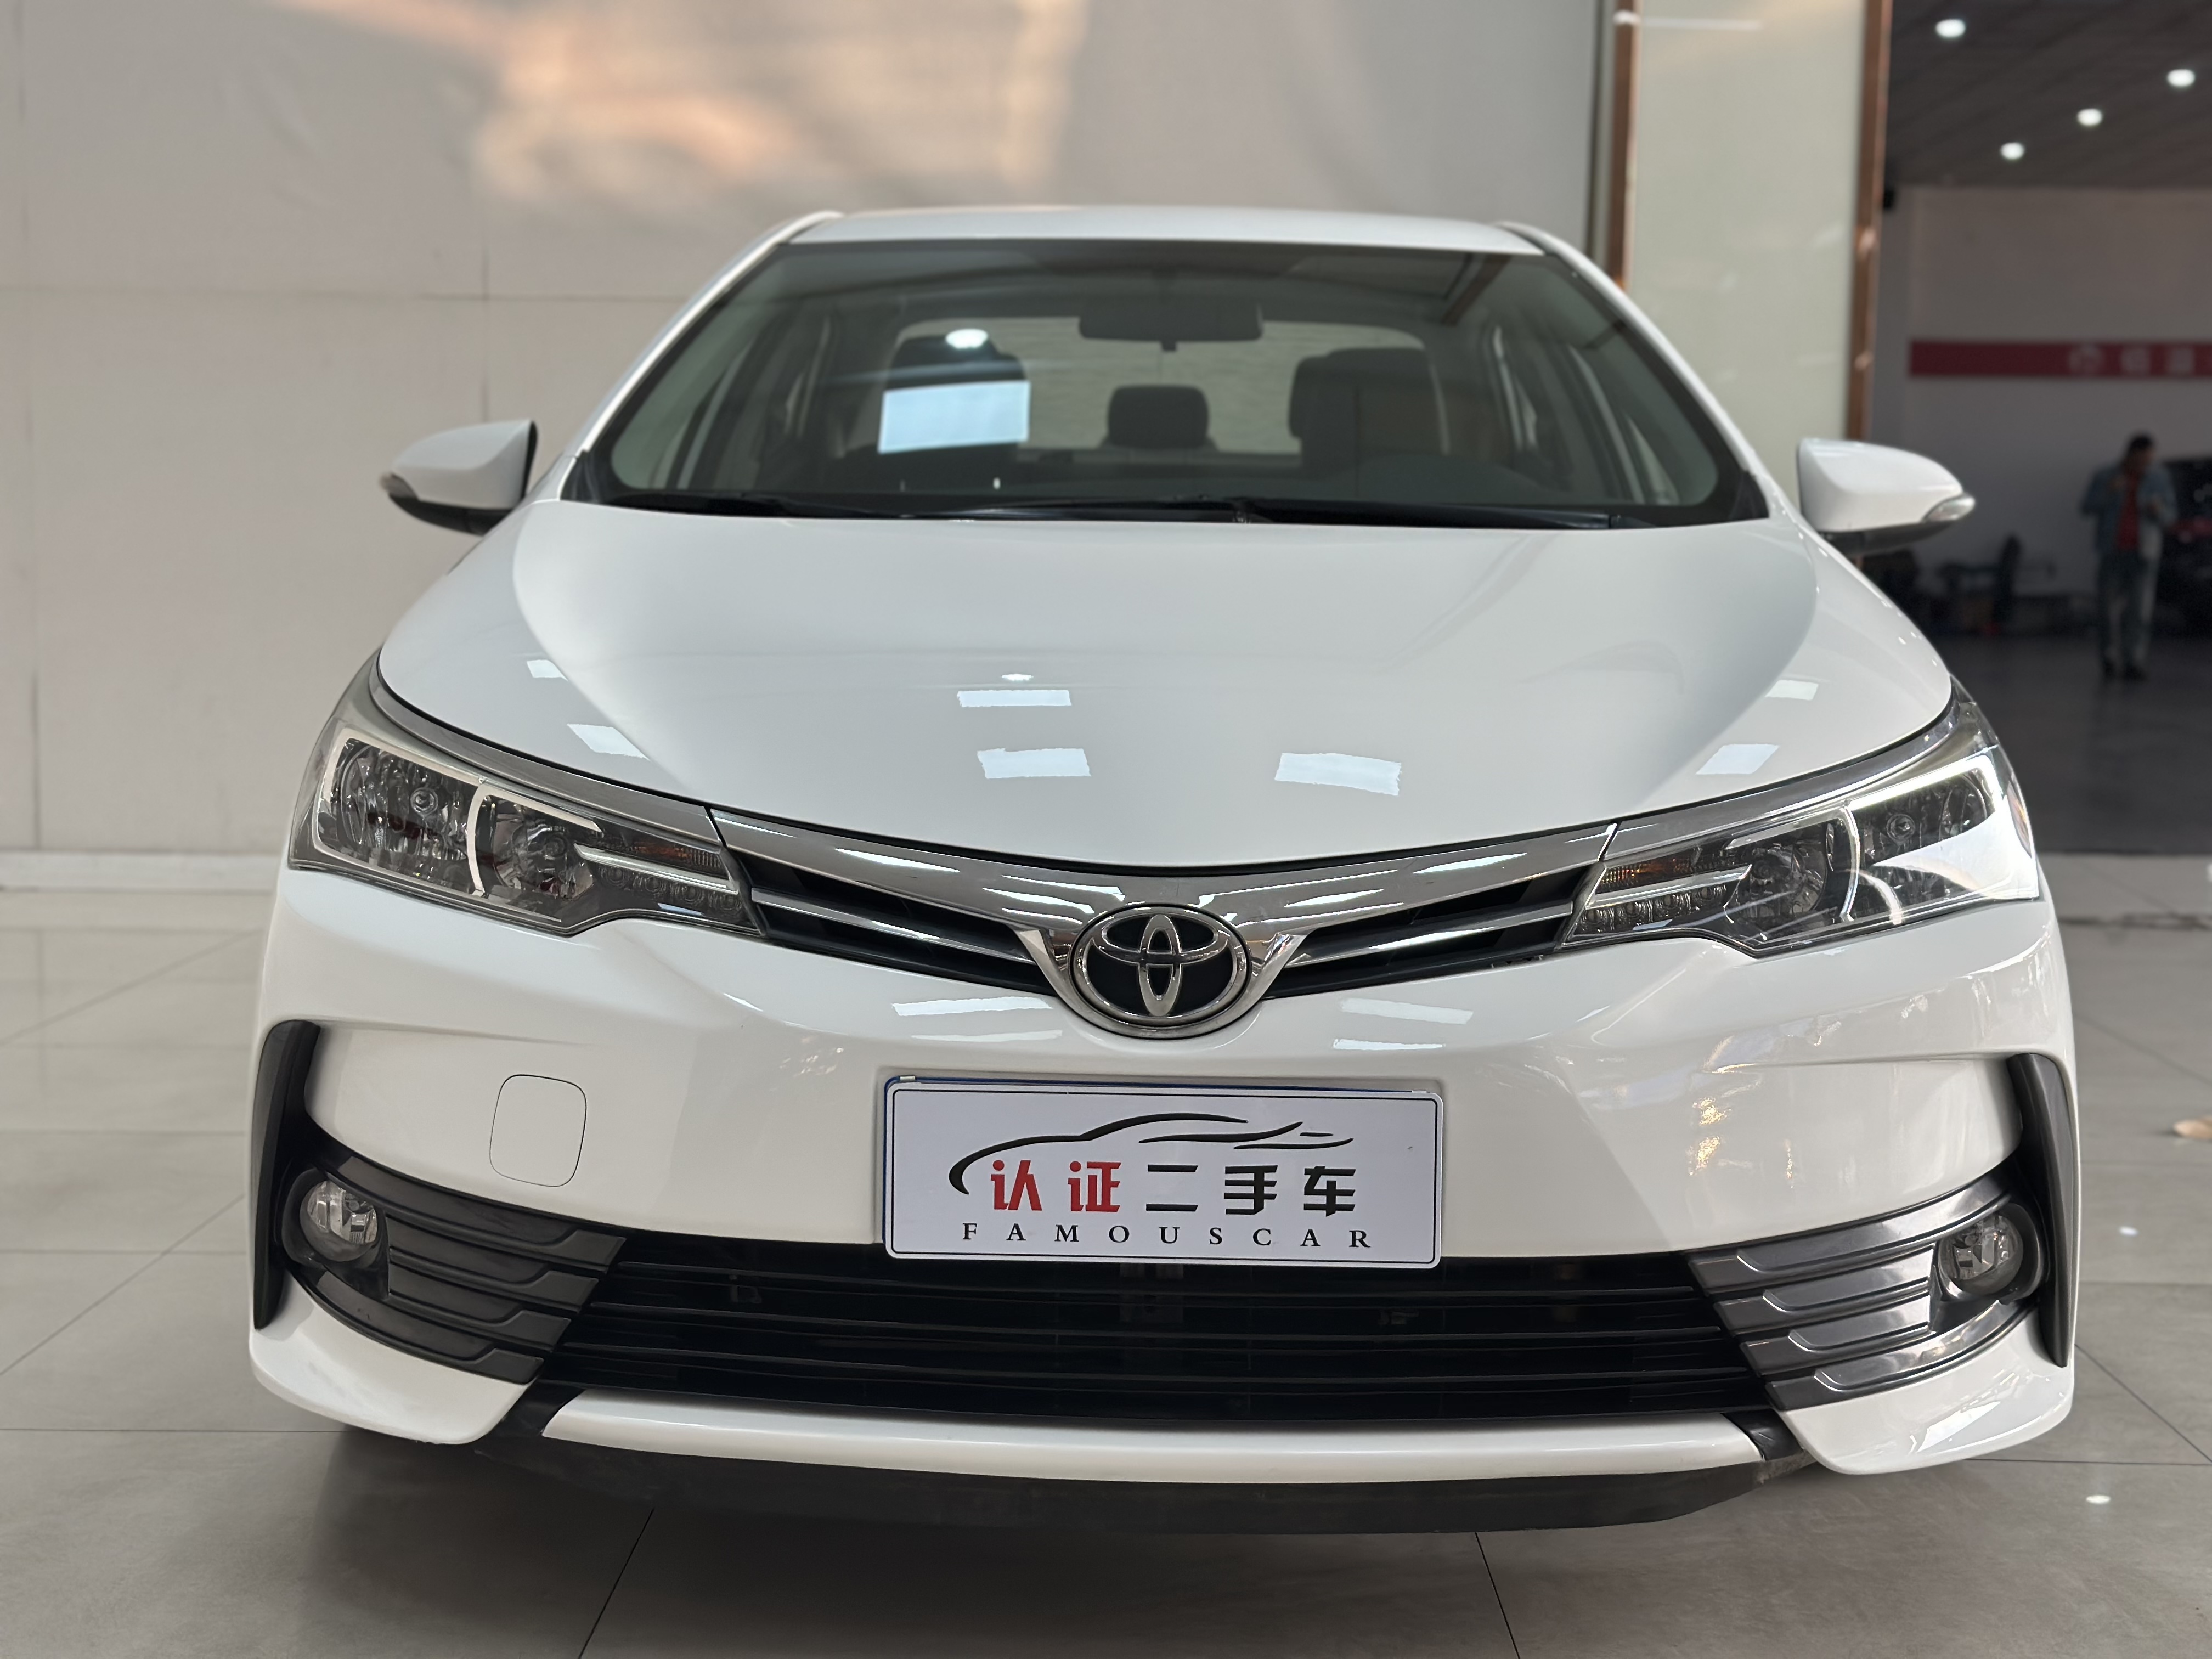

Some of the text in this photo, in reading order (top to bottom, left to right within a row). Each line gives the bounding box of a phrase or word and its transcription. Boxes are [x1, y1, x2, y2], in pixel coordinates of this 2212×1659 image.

[991, 1160, 1356, 1216] 认证二手车
